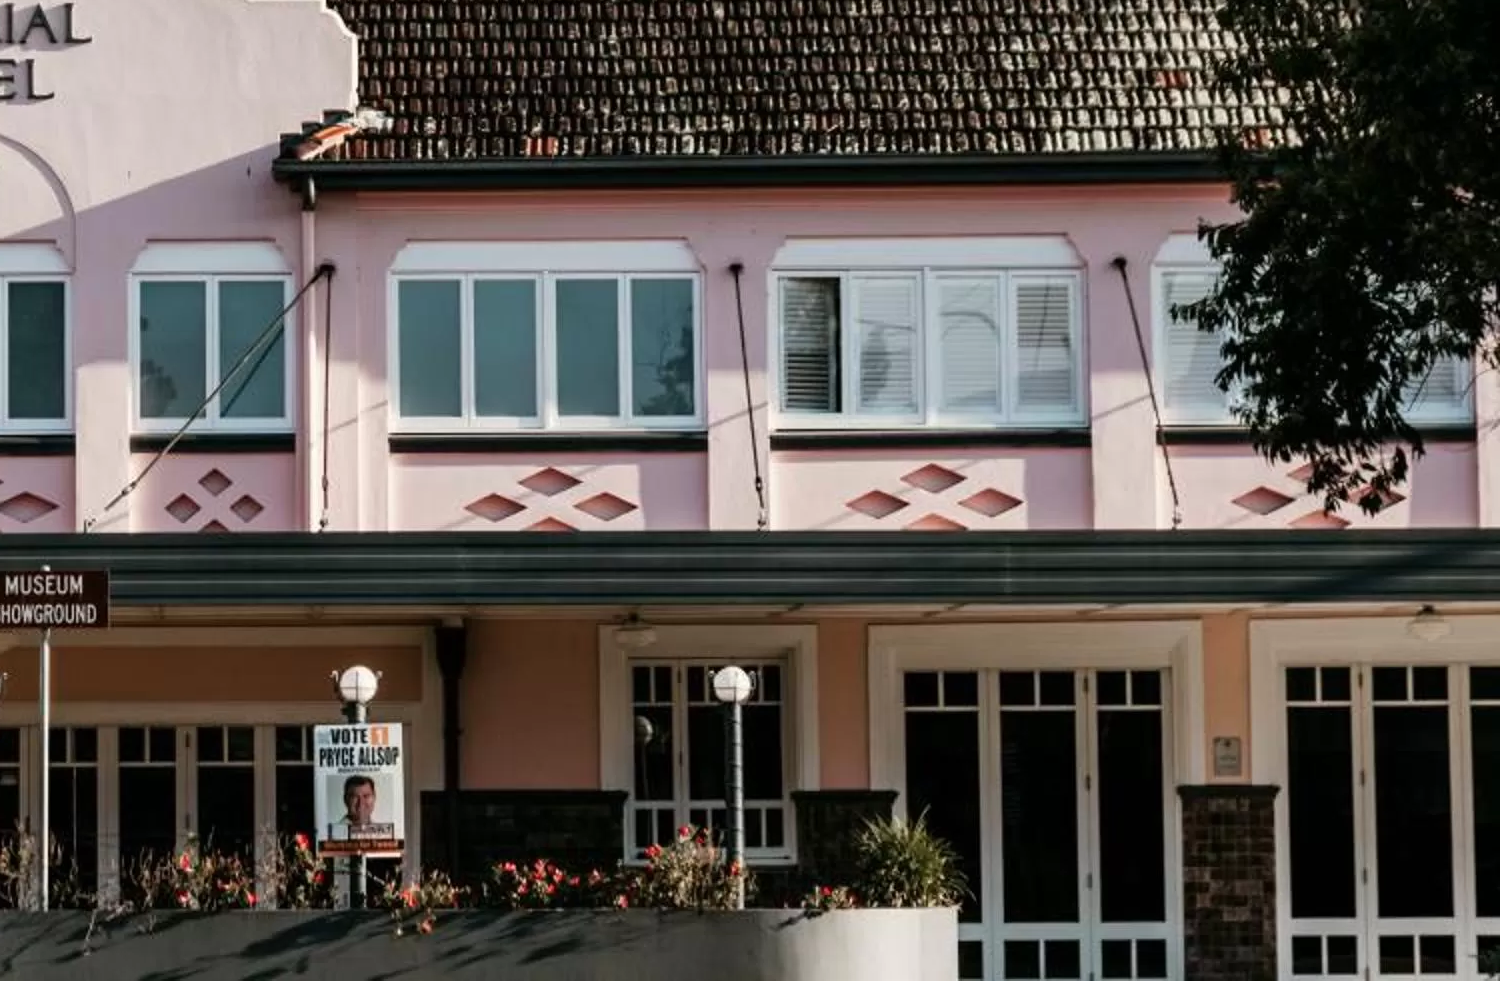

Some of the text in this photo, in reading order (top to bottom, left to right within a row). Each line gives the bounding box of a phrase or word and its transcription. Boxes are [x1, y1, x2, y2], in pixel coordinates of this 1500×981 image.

[5, 574, 83, 596] MUSEUM
[330, 727, 368, 745] VOTE
[319, 746, 399, 767] PRYCE ALLSOP
